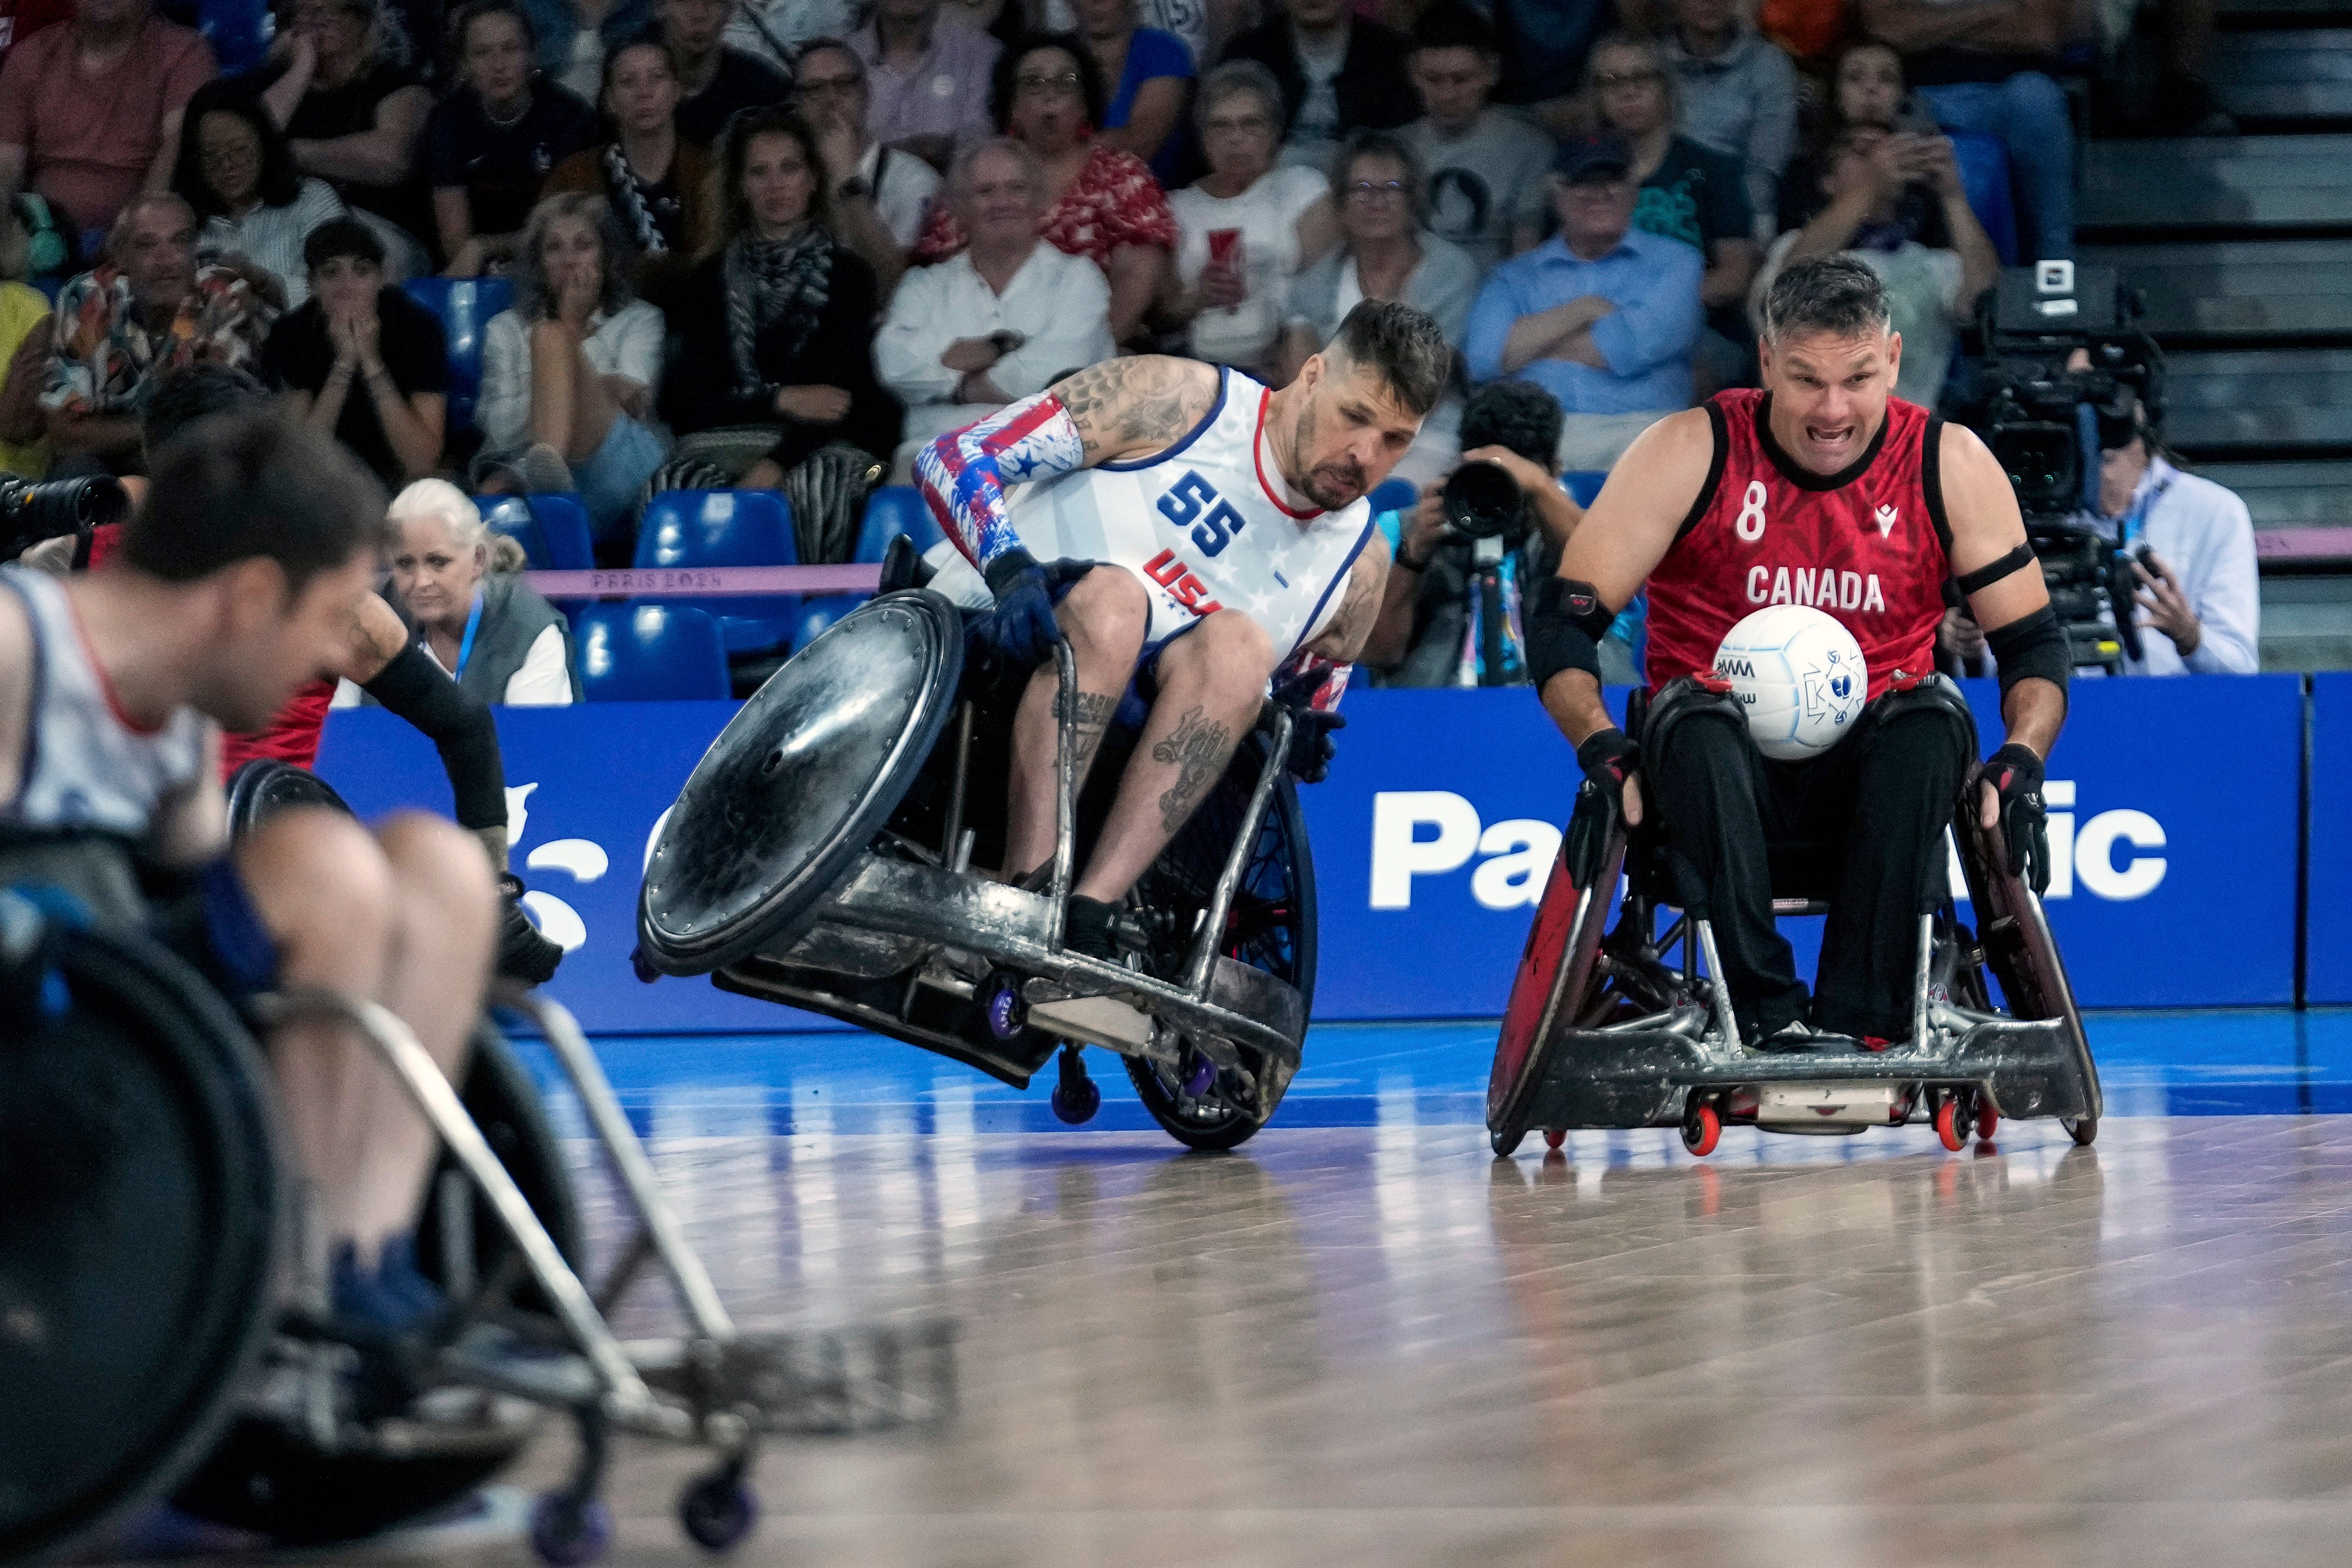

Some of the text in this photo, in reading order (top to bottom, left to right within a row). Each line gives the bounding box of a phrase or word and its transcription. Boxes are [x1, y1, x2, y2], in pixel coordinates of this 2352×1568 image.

[1156, 469, 1246, 558] 55
[1736, 480, 1768, 541] 8
[1747, 565, 1886, 613] CANADA
